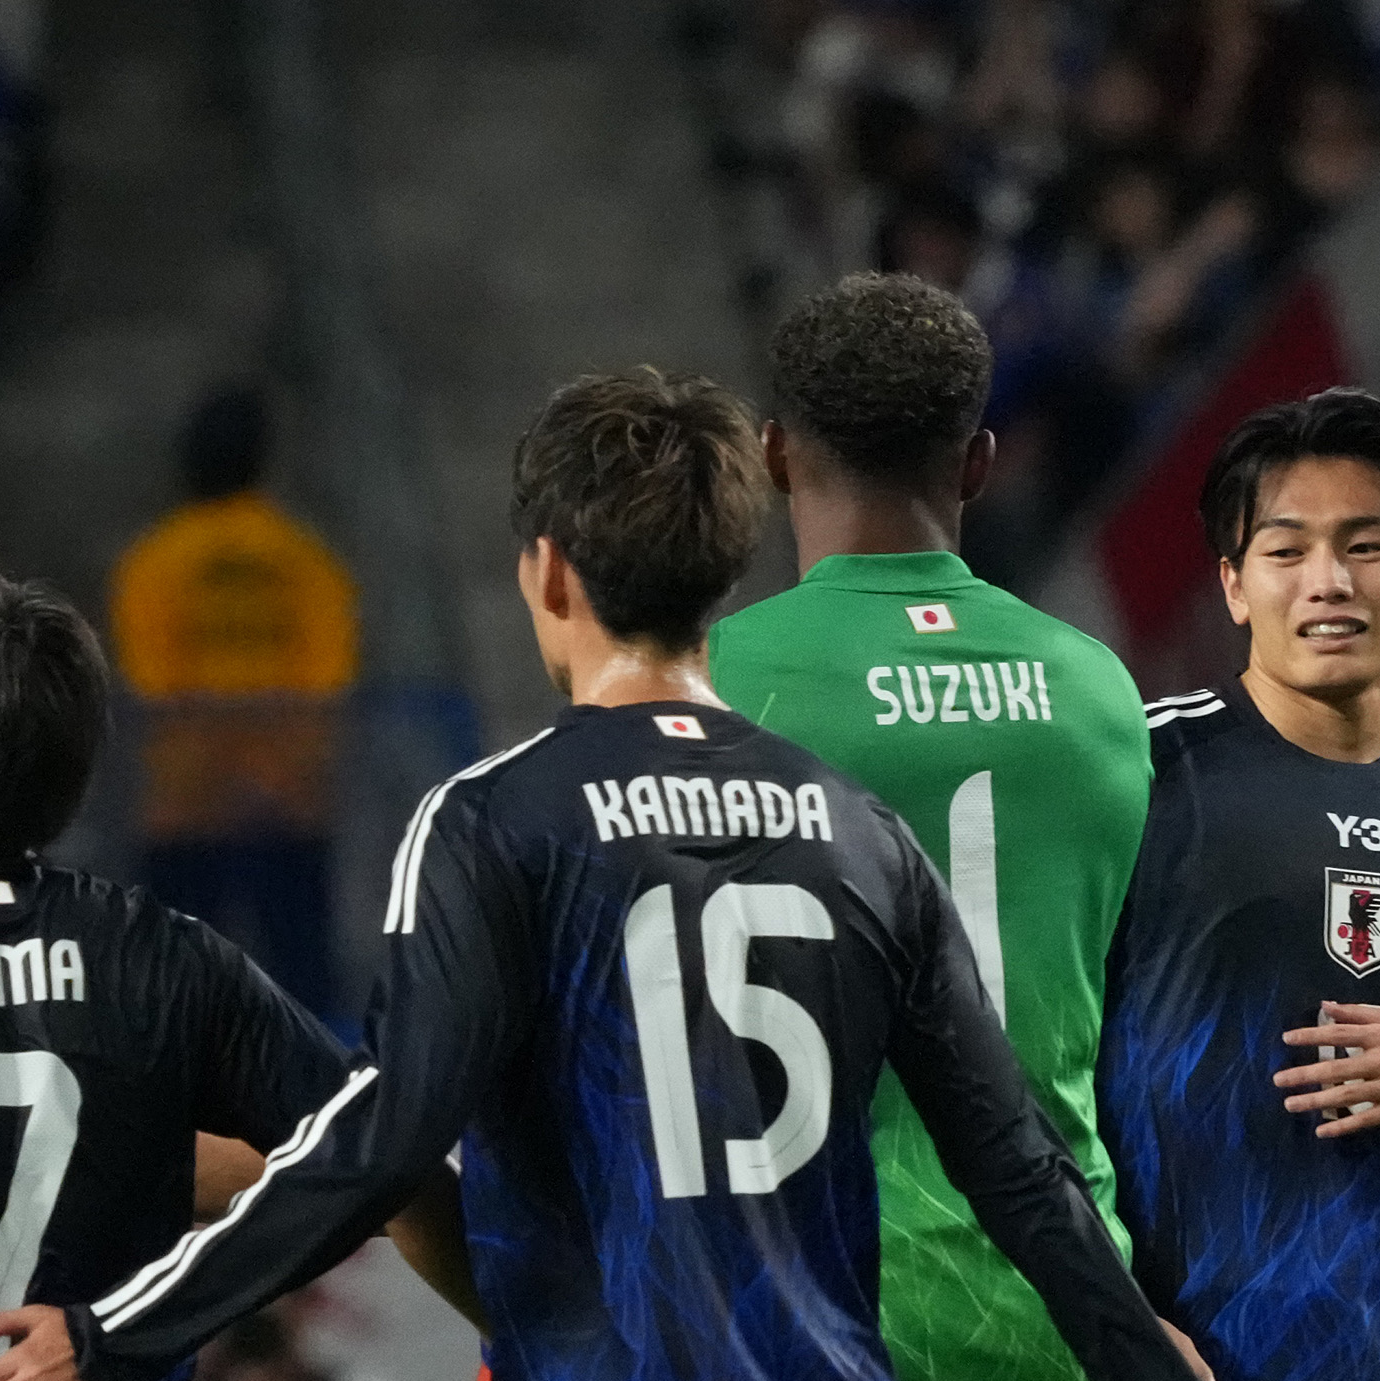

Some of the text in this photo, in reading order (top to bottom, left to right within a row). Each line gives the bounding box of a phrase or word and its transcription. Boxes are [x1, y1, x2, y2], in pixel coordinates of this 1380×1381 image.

[867, 662, 1052, 725] SUZUKI
[582, 775, 833, 842] KAMADA
[949, 770, 1006, 1031] 1
[624, 883, 836, 1199] 15
